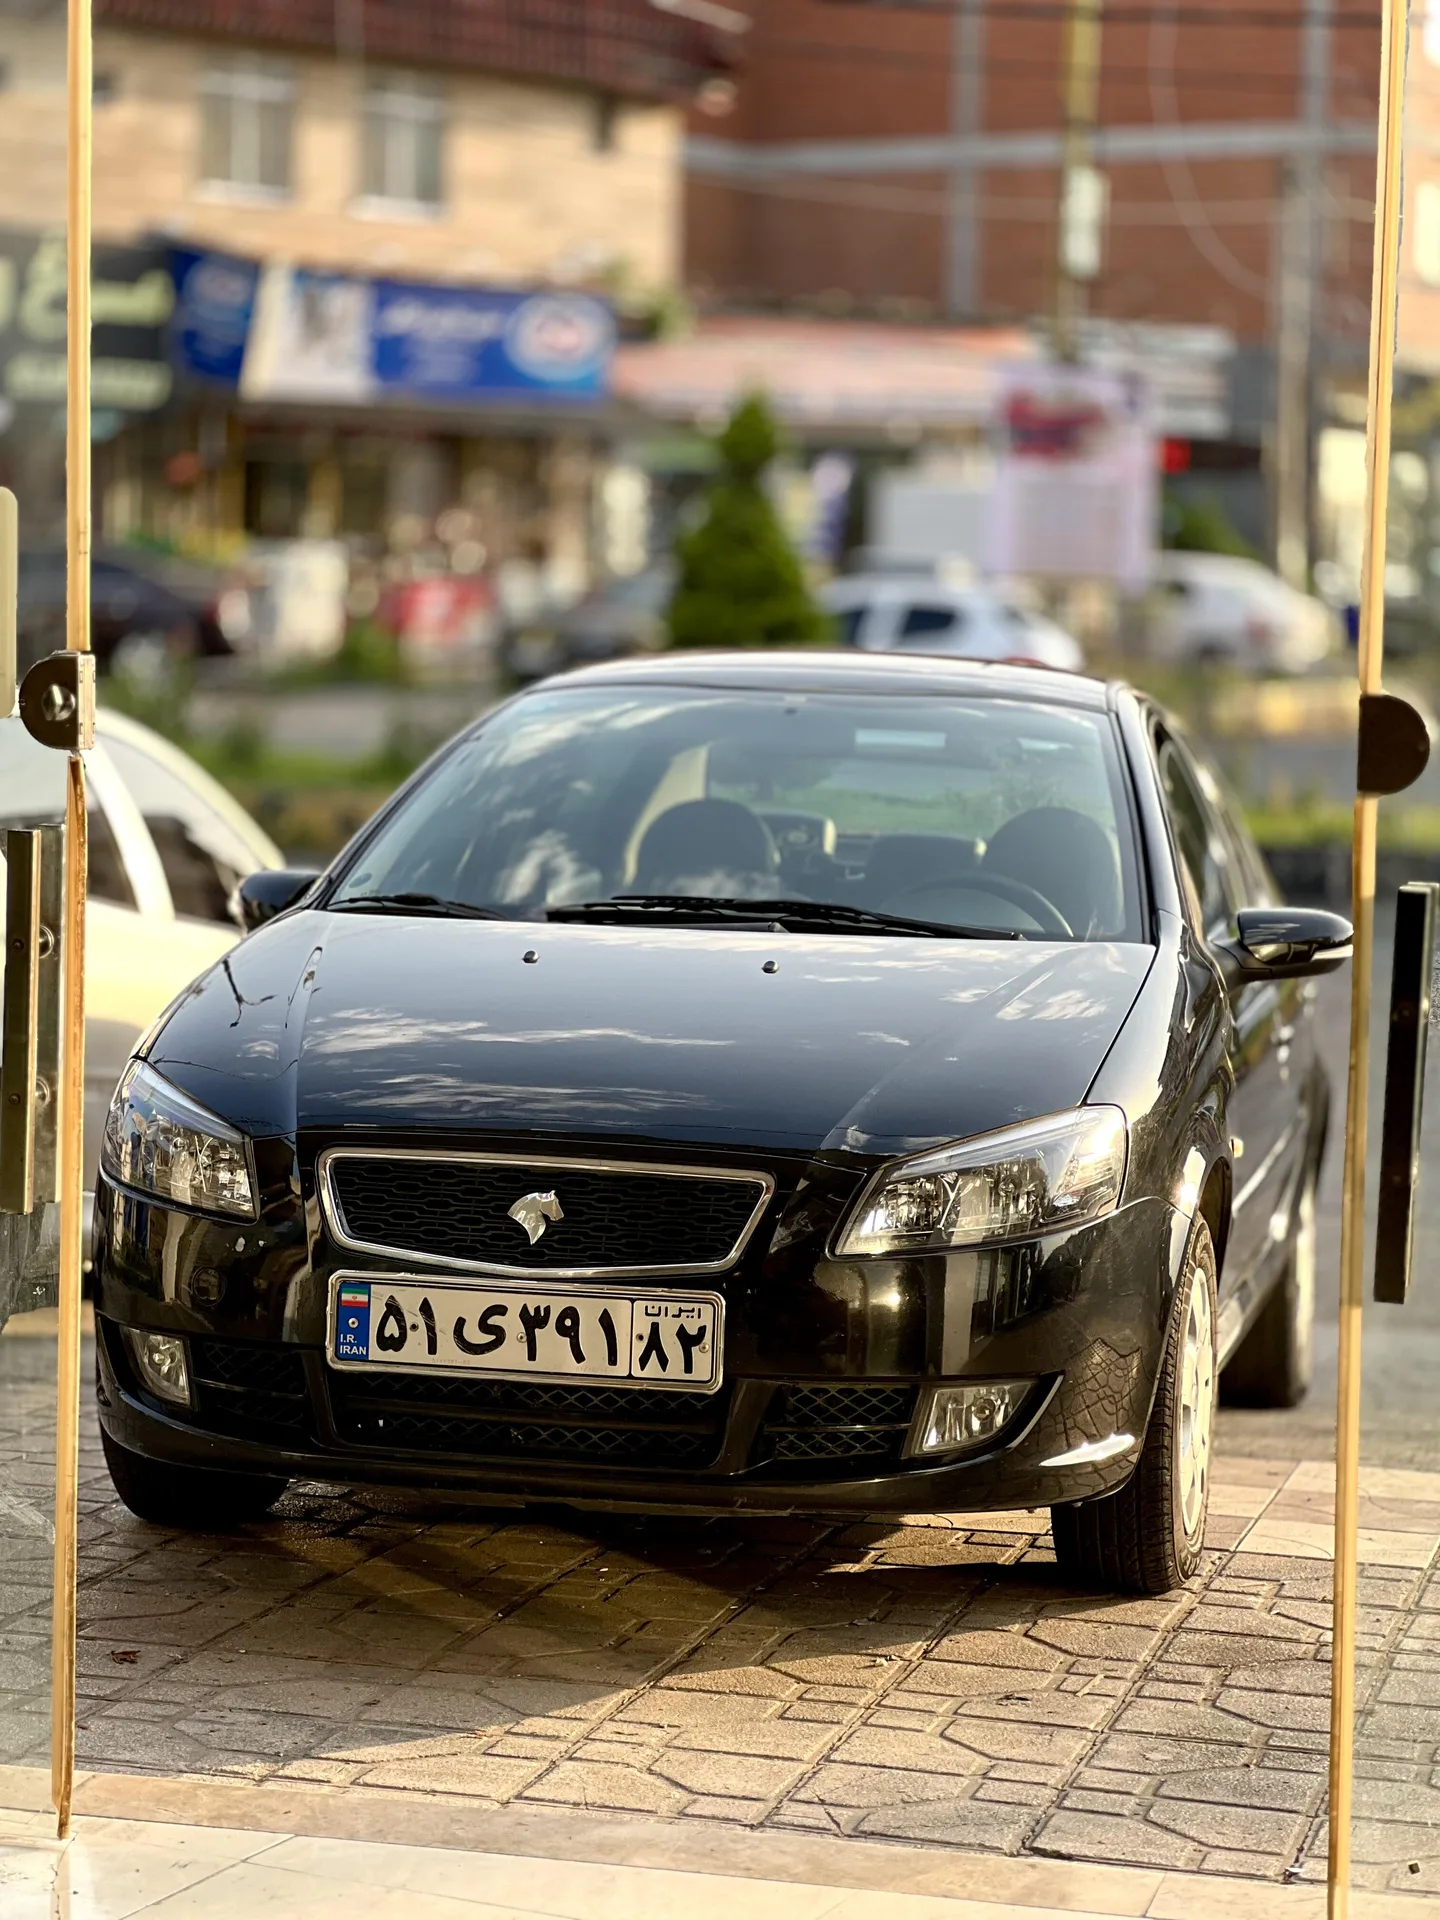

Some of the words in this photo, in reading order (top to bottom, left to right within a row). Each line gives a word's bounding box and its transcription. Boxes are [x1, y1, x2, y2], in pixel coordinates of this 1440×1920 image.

[644, 1305, 702, 1319] ایران
[340, 1333, 358, 1344] I.R.
[339, 1345, 367, 1356] IRAN
[638, 1321, 707, 1374] ۸۲
